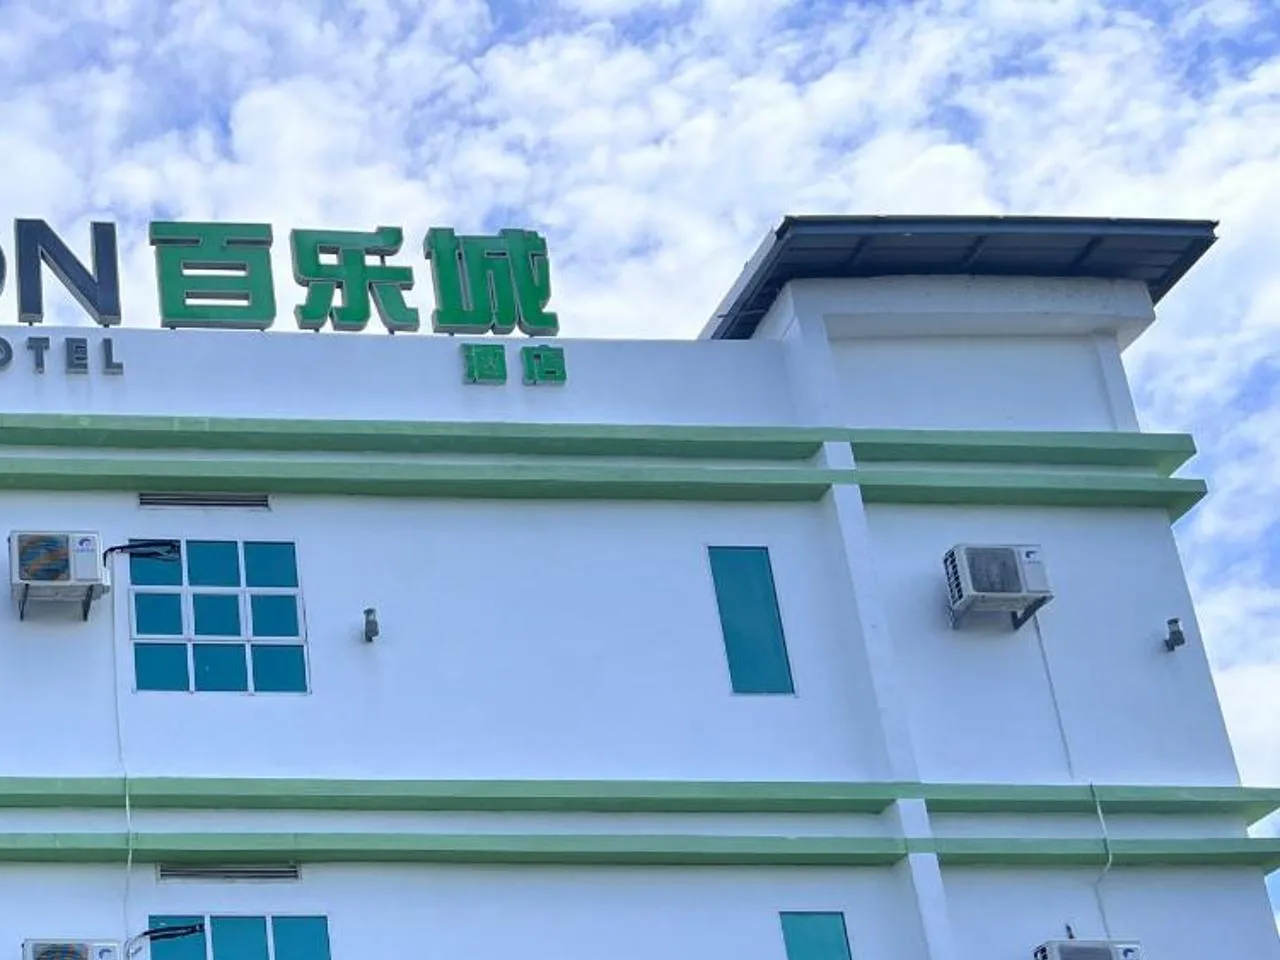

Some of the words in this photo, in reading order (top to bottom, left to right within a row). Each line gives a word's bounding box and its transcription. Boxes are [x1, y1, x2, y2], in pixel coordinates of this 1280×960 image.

[149, 220, 559, 336] 百乐城
[460, 344, 567, 386] 酒店
